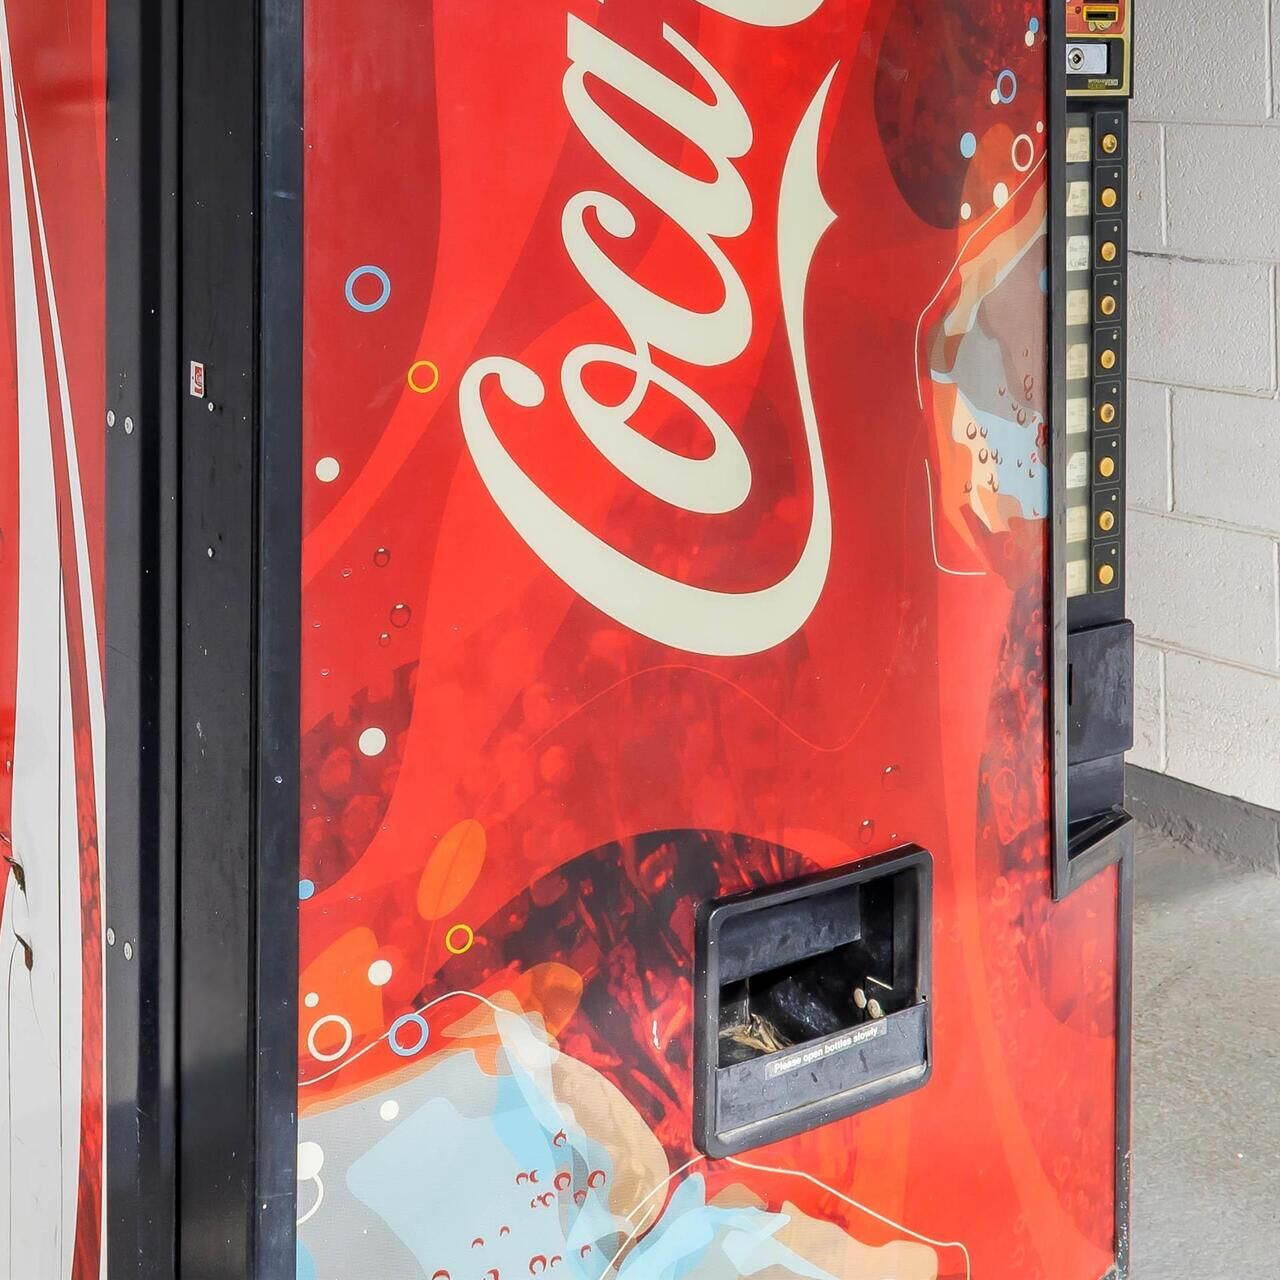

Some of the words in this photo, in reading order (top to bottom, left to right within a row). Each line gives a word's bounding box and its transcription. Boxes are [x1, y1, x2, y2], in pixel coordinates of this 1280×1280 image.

[774, 1056, 802, 1073] Please
[803, 1048, 824, 1063] open
[824, 1037, 852, 1054] bottles
